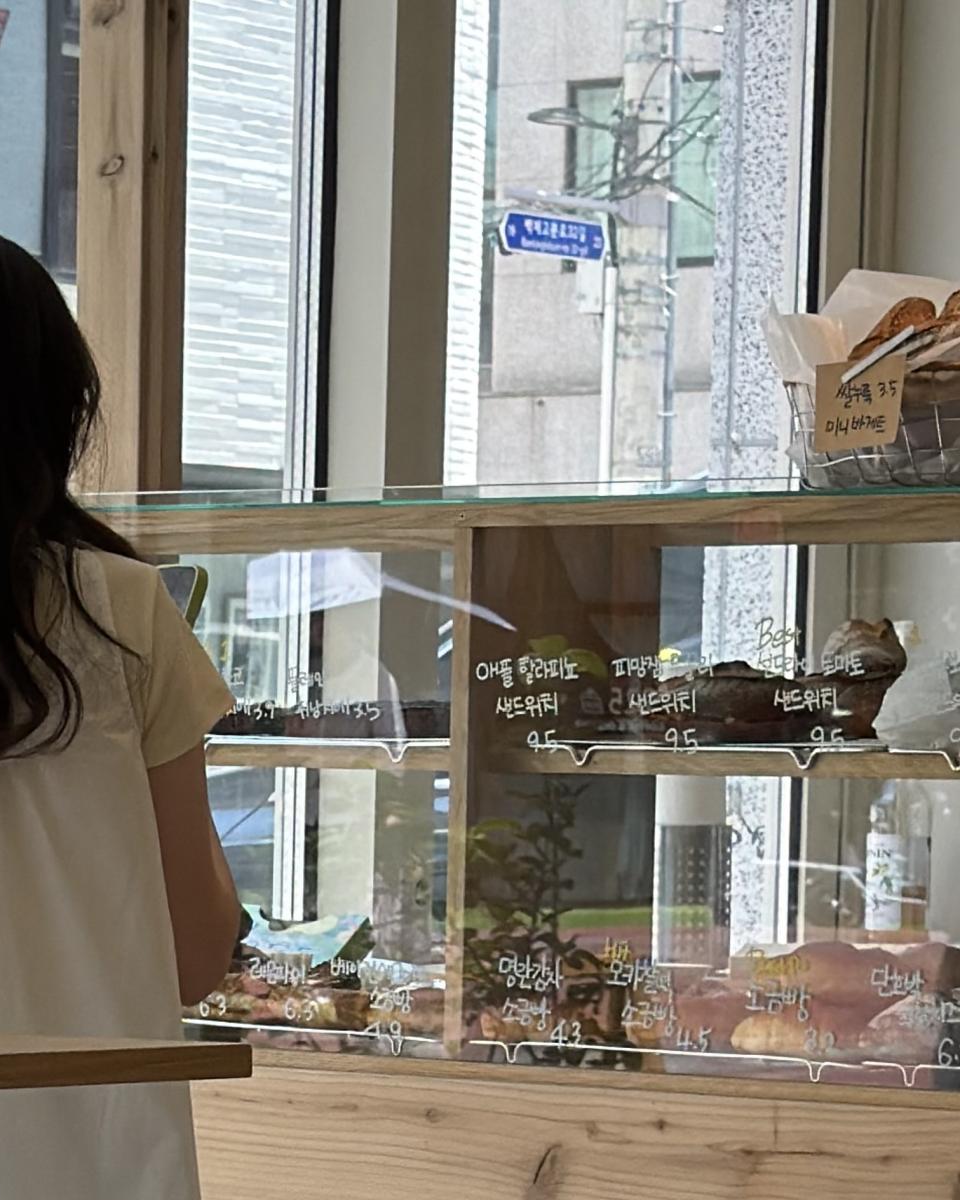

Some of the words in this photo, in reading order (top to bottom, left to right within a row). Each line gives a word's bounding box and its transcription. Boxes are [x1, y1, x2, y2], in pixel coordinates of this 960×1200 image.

[824, 418, 849, 437] 미니
[475, 658, 514, 688] 애플
[517, 655, 580, 684] 할라피뇨
[821, 653, 865, 676] 토마토
[496, 692, 559, 719] 샌드위치
[628, 688, 697, 716] 샌드위치
[773, 687, 838, 712] 샌드위치
[498, 951, 564, 991] 명란감자
[502, 995, 552, 1031] 소금빵
[621, 993, 678, 1036] 소금빵
[677, 1026, 713, 1053] 4.5
[938, 1037, 960, 1066] 6.
